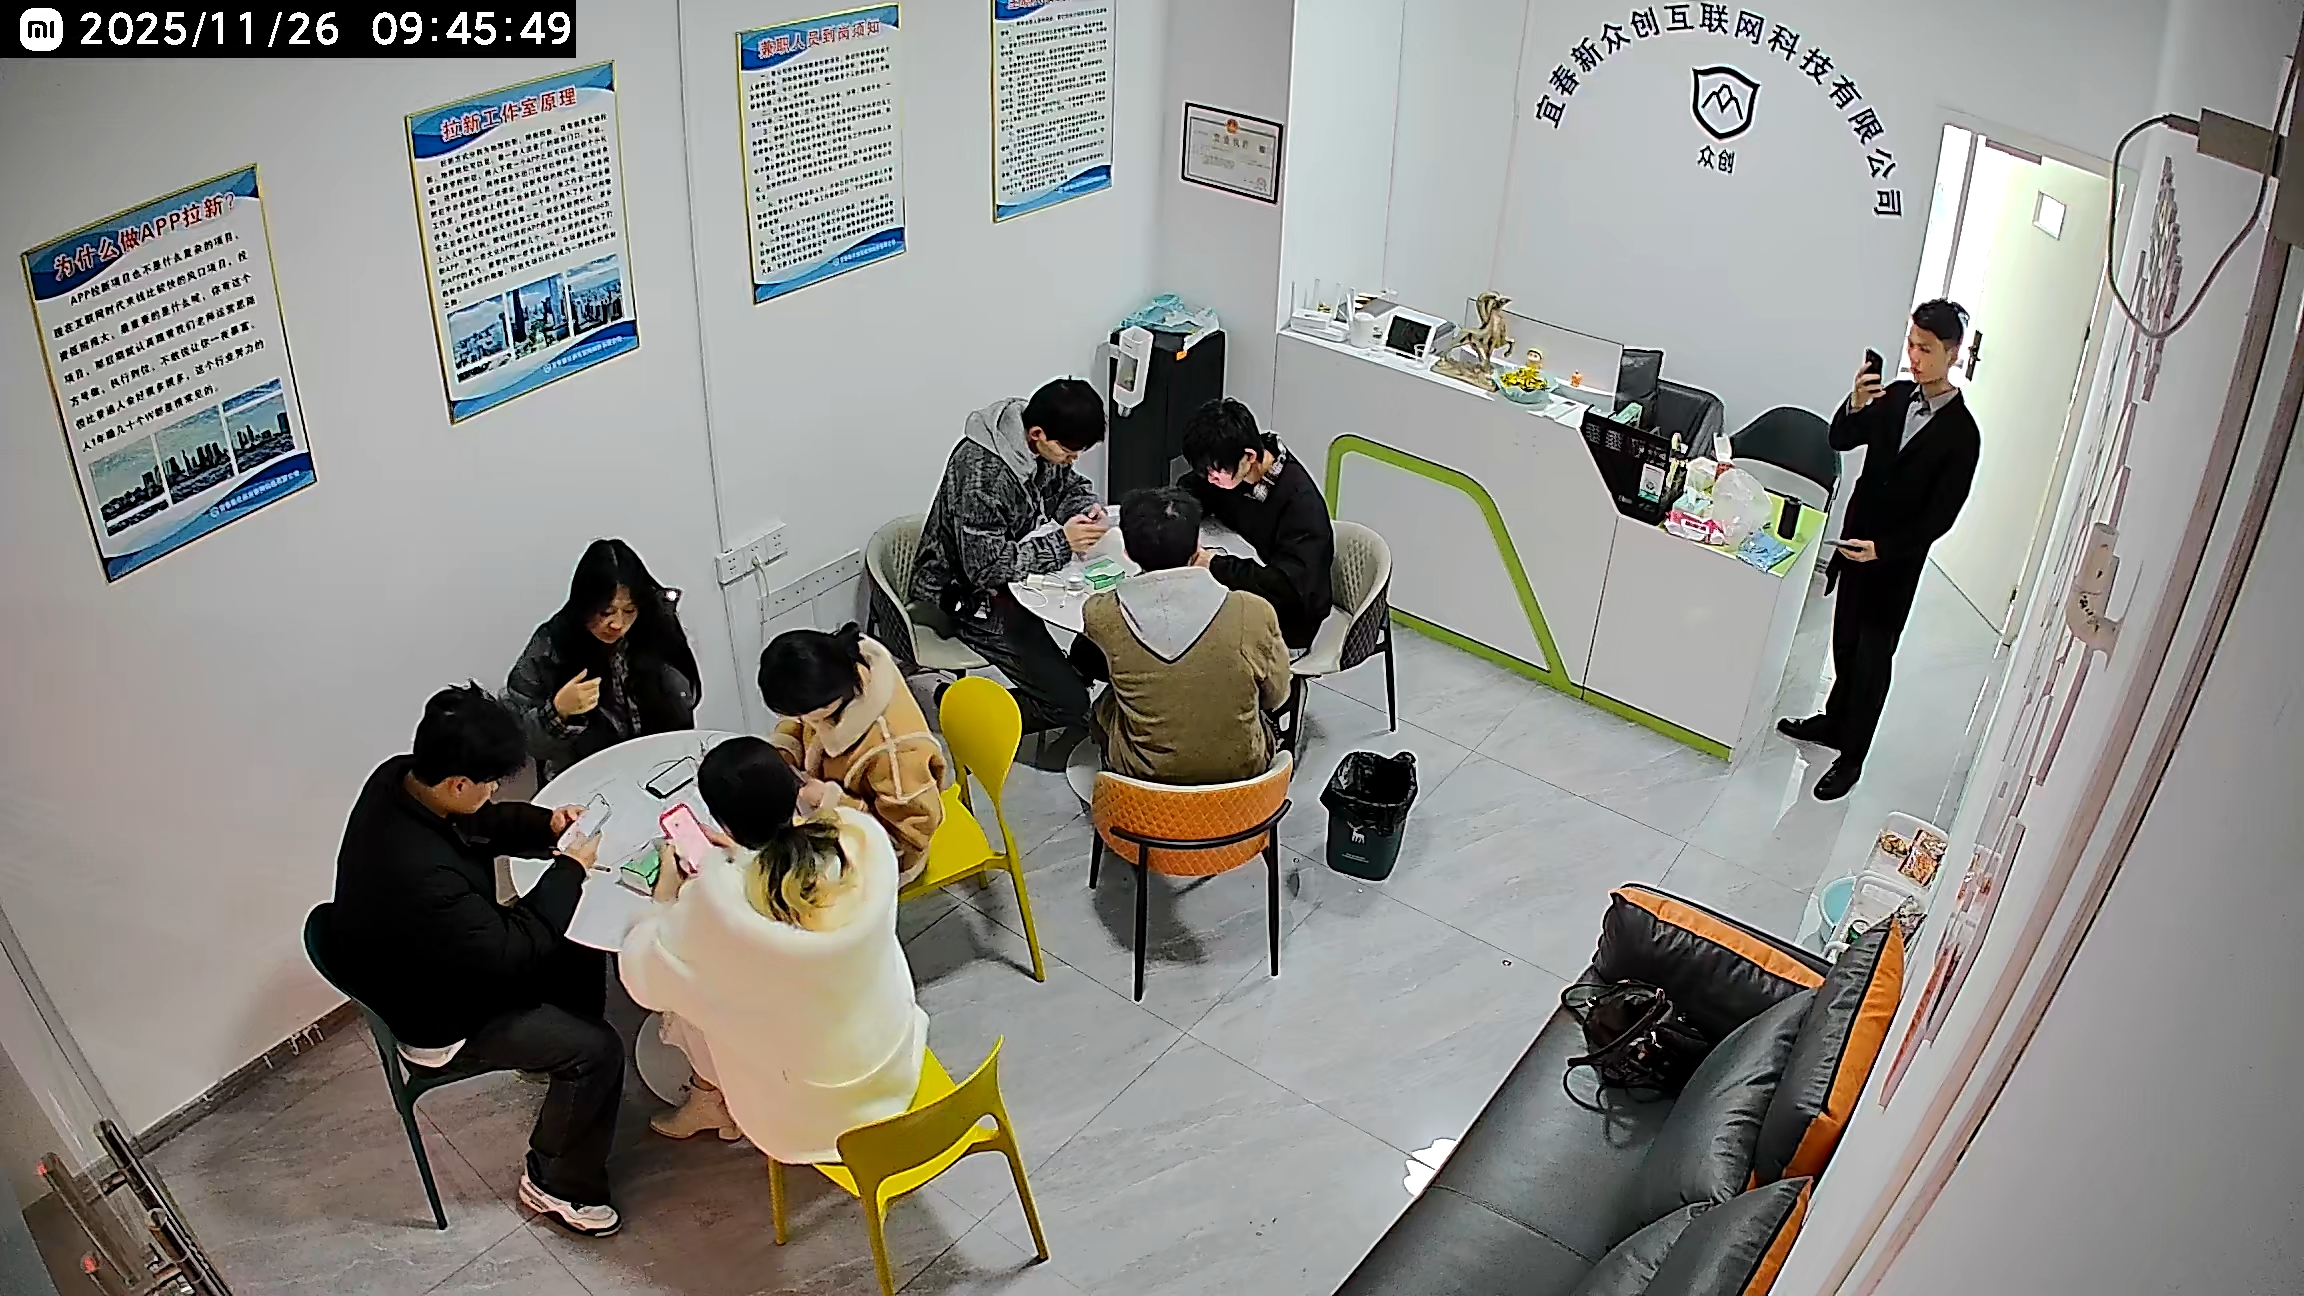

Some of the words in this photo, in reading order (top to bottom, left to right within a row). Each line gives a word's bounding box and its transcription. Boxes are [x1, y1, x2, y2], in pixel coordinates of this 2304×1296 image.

[759, 19, 881, 58] 兼职人员到岗须知
[440, 86, 577, 141] 拉新工作室原理
[1536, 3, 1902, 218] 宜春新众创互联网科技有限公司
[1697, 145, 1735, 174] 众创
